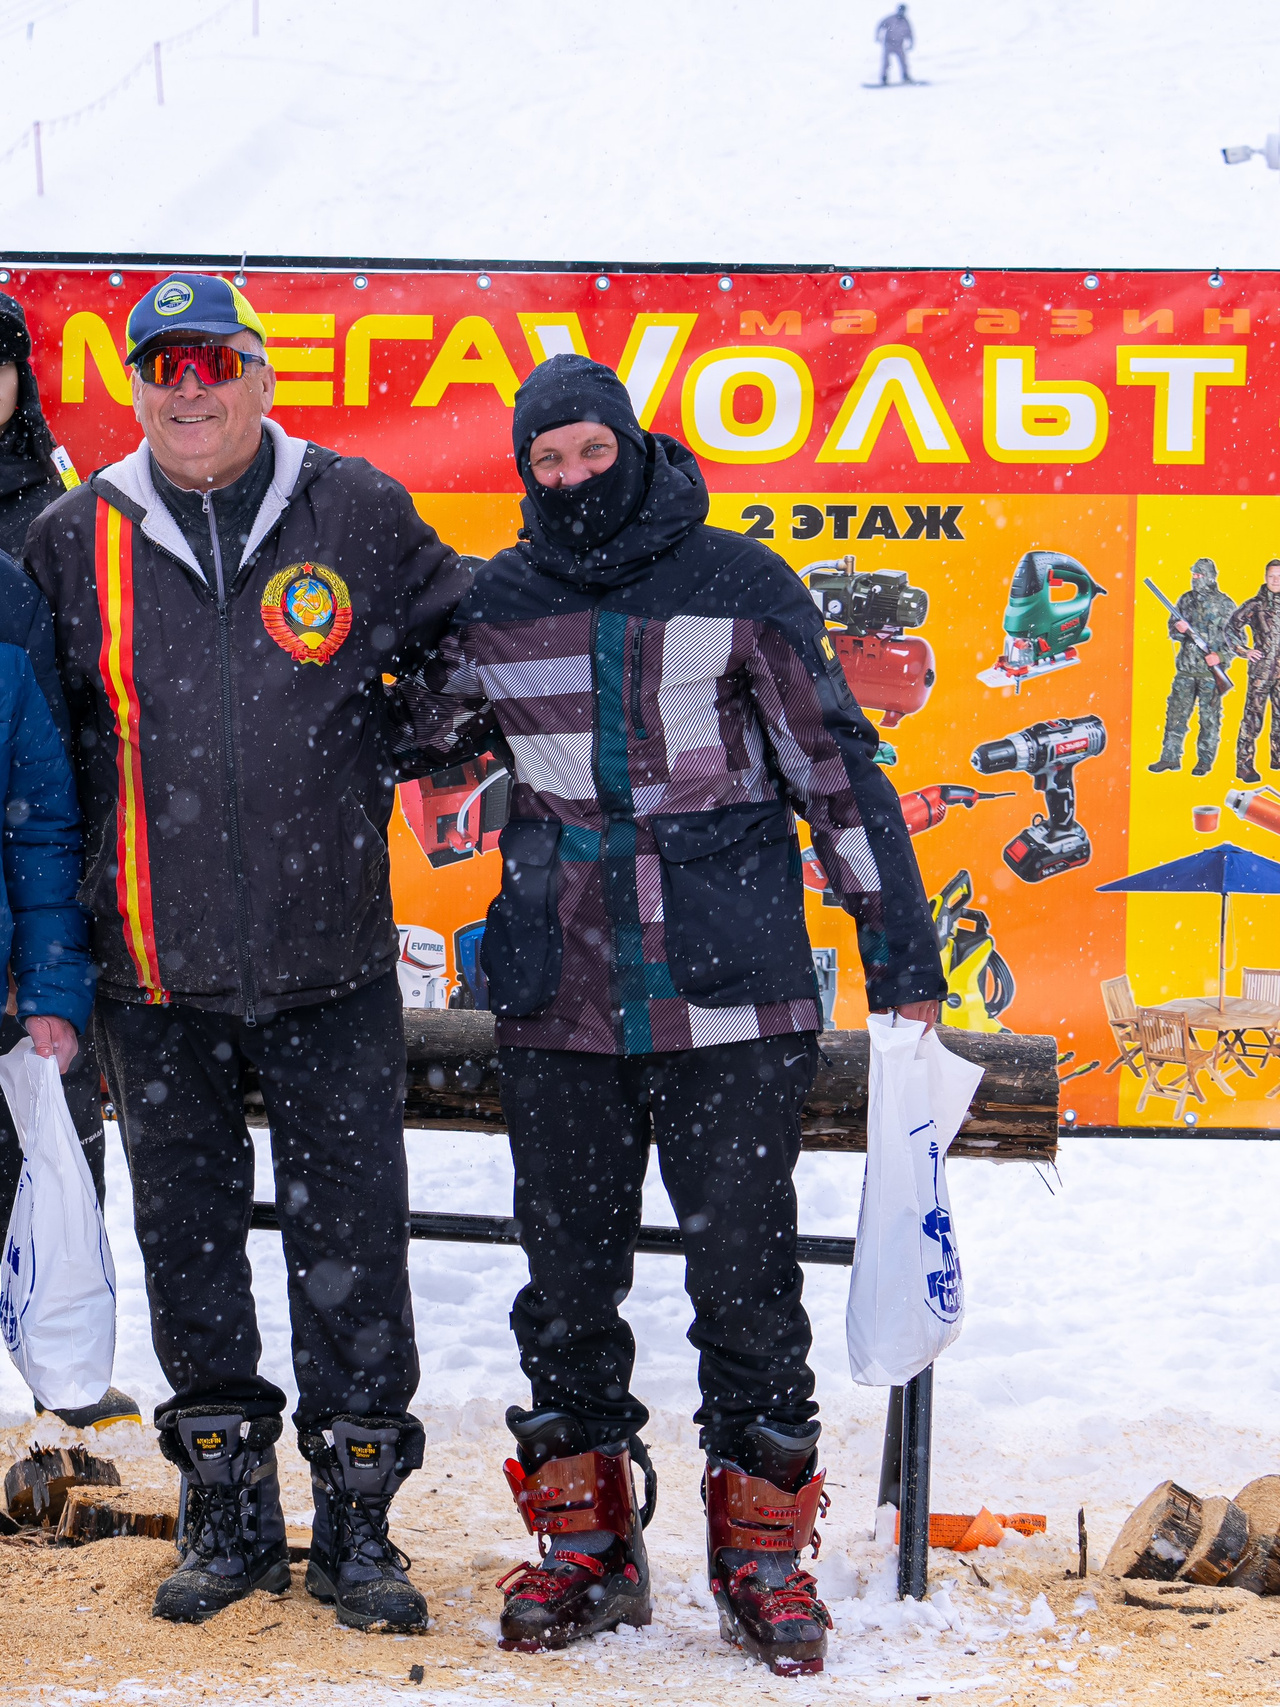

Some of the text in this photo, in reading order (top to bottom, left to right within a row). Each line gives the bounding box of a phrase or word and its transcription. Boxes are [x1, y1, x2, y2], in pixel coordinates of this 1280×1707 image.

[739, 307, 1252, 337] магазин
[740, 504, 966, 540] 2 ЭТАЖ
[411, 941, 444, 953] EVINRUDE
